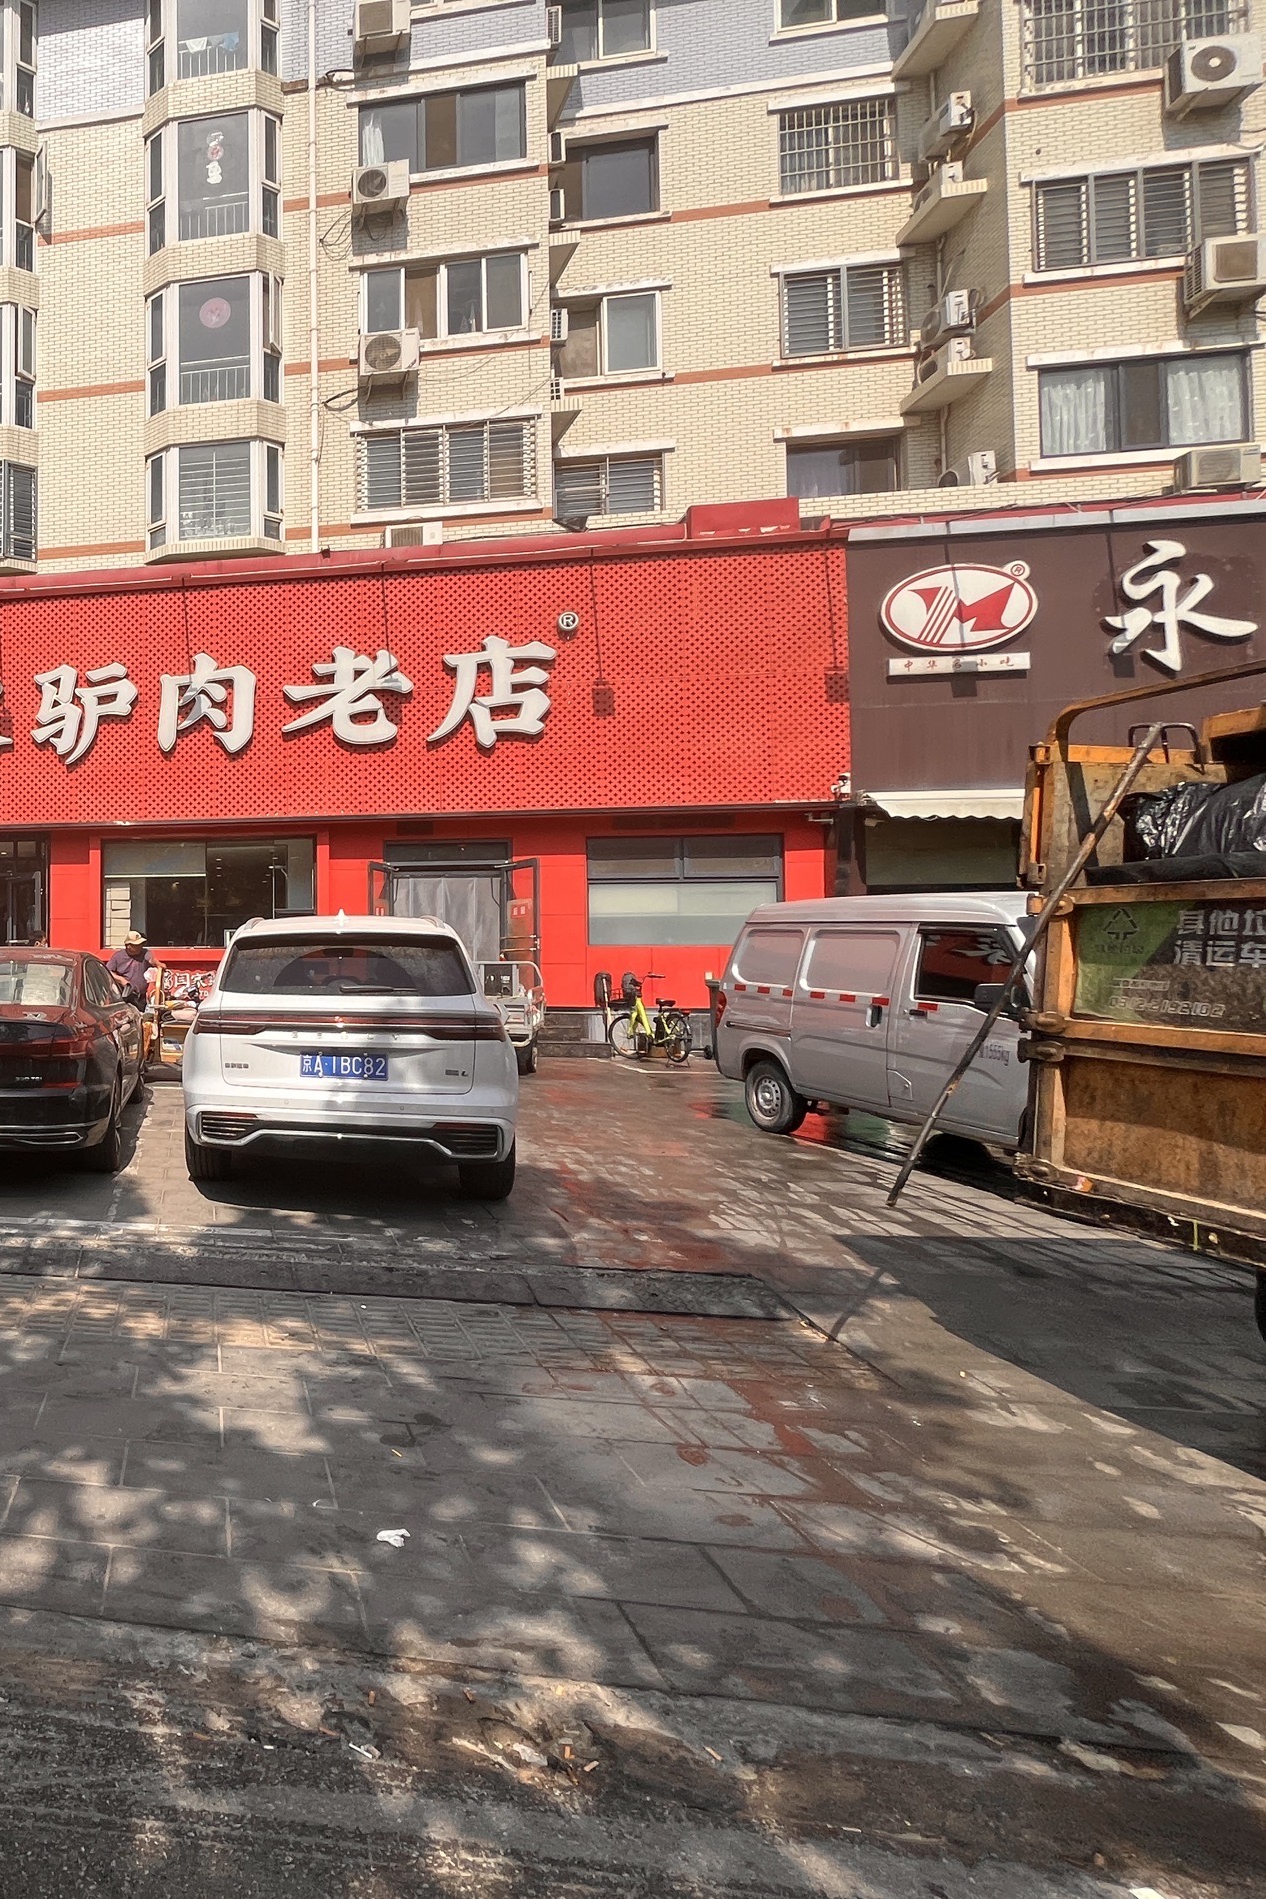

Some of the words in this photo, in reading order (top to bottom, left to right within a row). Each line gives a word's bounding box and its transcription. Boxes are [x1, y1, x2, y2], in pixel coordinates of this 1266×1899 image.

[1103, 541, 1259, 671] 永
[1173, 940, 1266, 968] 清运车
